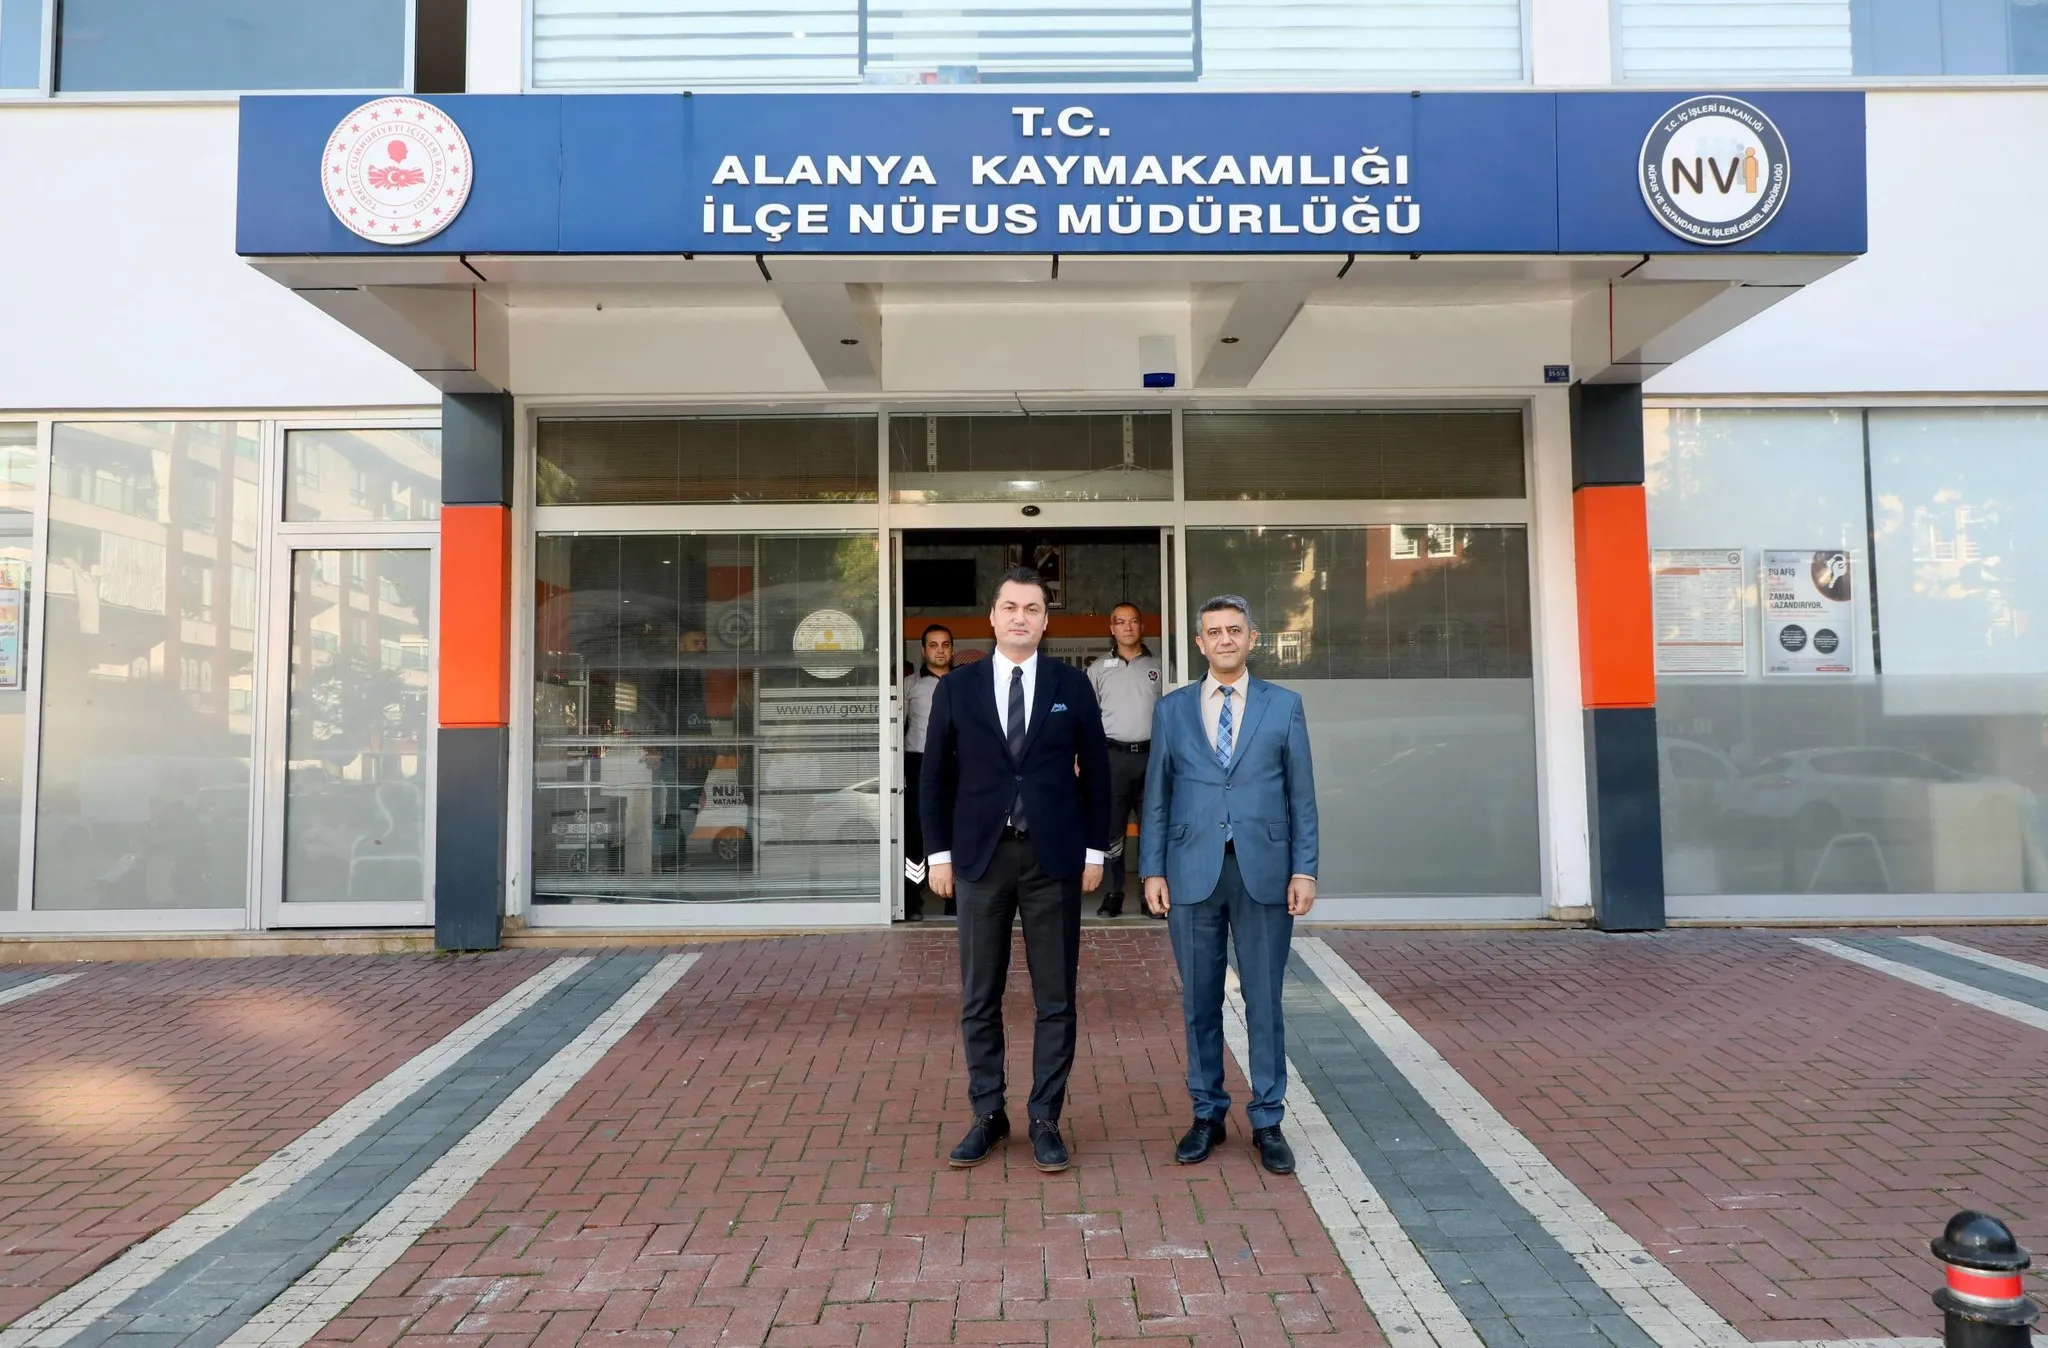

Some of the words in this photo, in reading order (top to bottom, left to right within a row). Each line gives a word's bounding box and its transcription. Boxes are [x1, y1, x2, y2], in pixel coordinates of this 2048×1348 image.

[1012, 106, 1110, 137] T.C.
[1664, 120, 1680, 133] T.C.
[1719, 105, 1764, 132] BAKANLIĞI
[711, 155, 937, 185] ALANYA
[972, 146, 1408, 185] KAYMAKAMLIĞI
[703, 195, 829, 242] İLÇE
[849, 195, 1038, 235] NÜFUS
[1058, 195, 1421, 235] MÜDÜRLÜĞÜ
[1648, 164, 1659, 193] NÜFUS
[1655, 192, 1665, 205] VE
[1662, 203, 1711, 236] VATANDAŞLIK
[1712, 224, 1739, 238] İŞLERİ
[1739, 213, 1765, 231] GENEL
[1761, 163, 1783, 214] MÜDÜRLÜĞÜ
